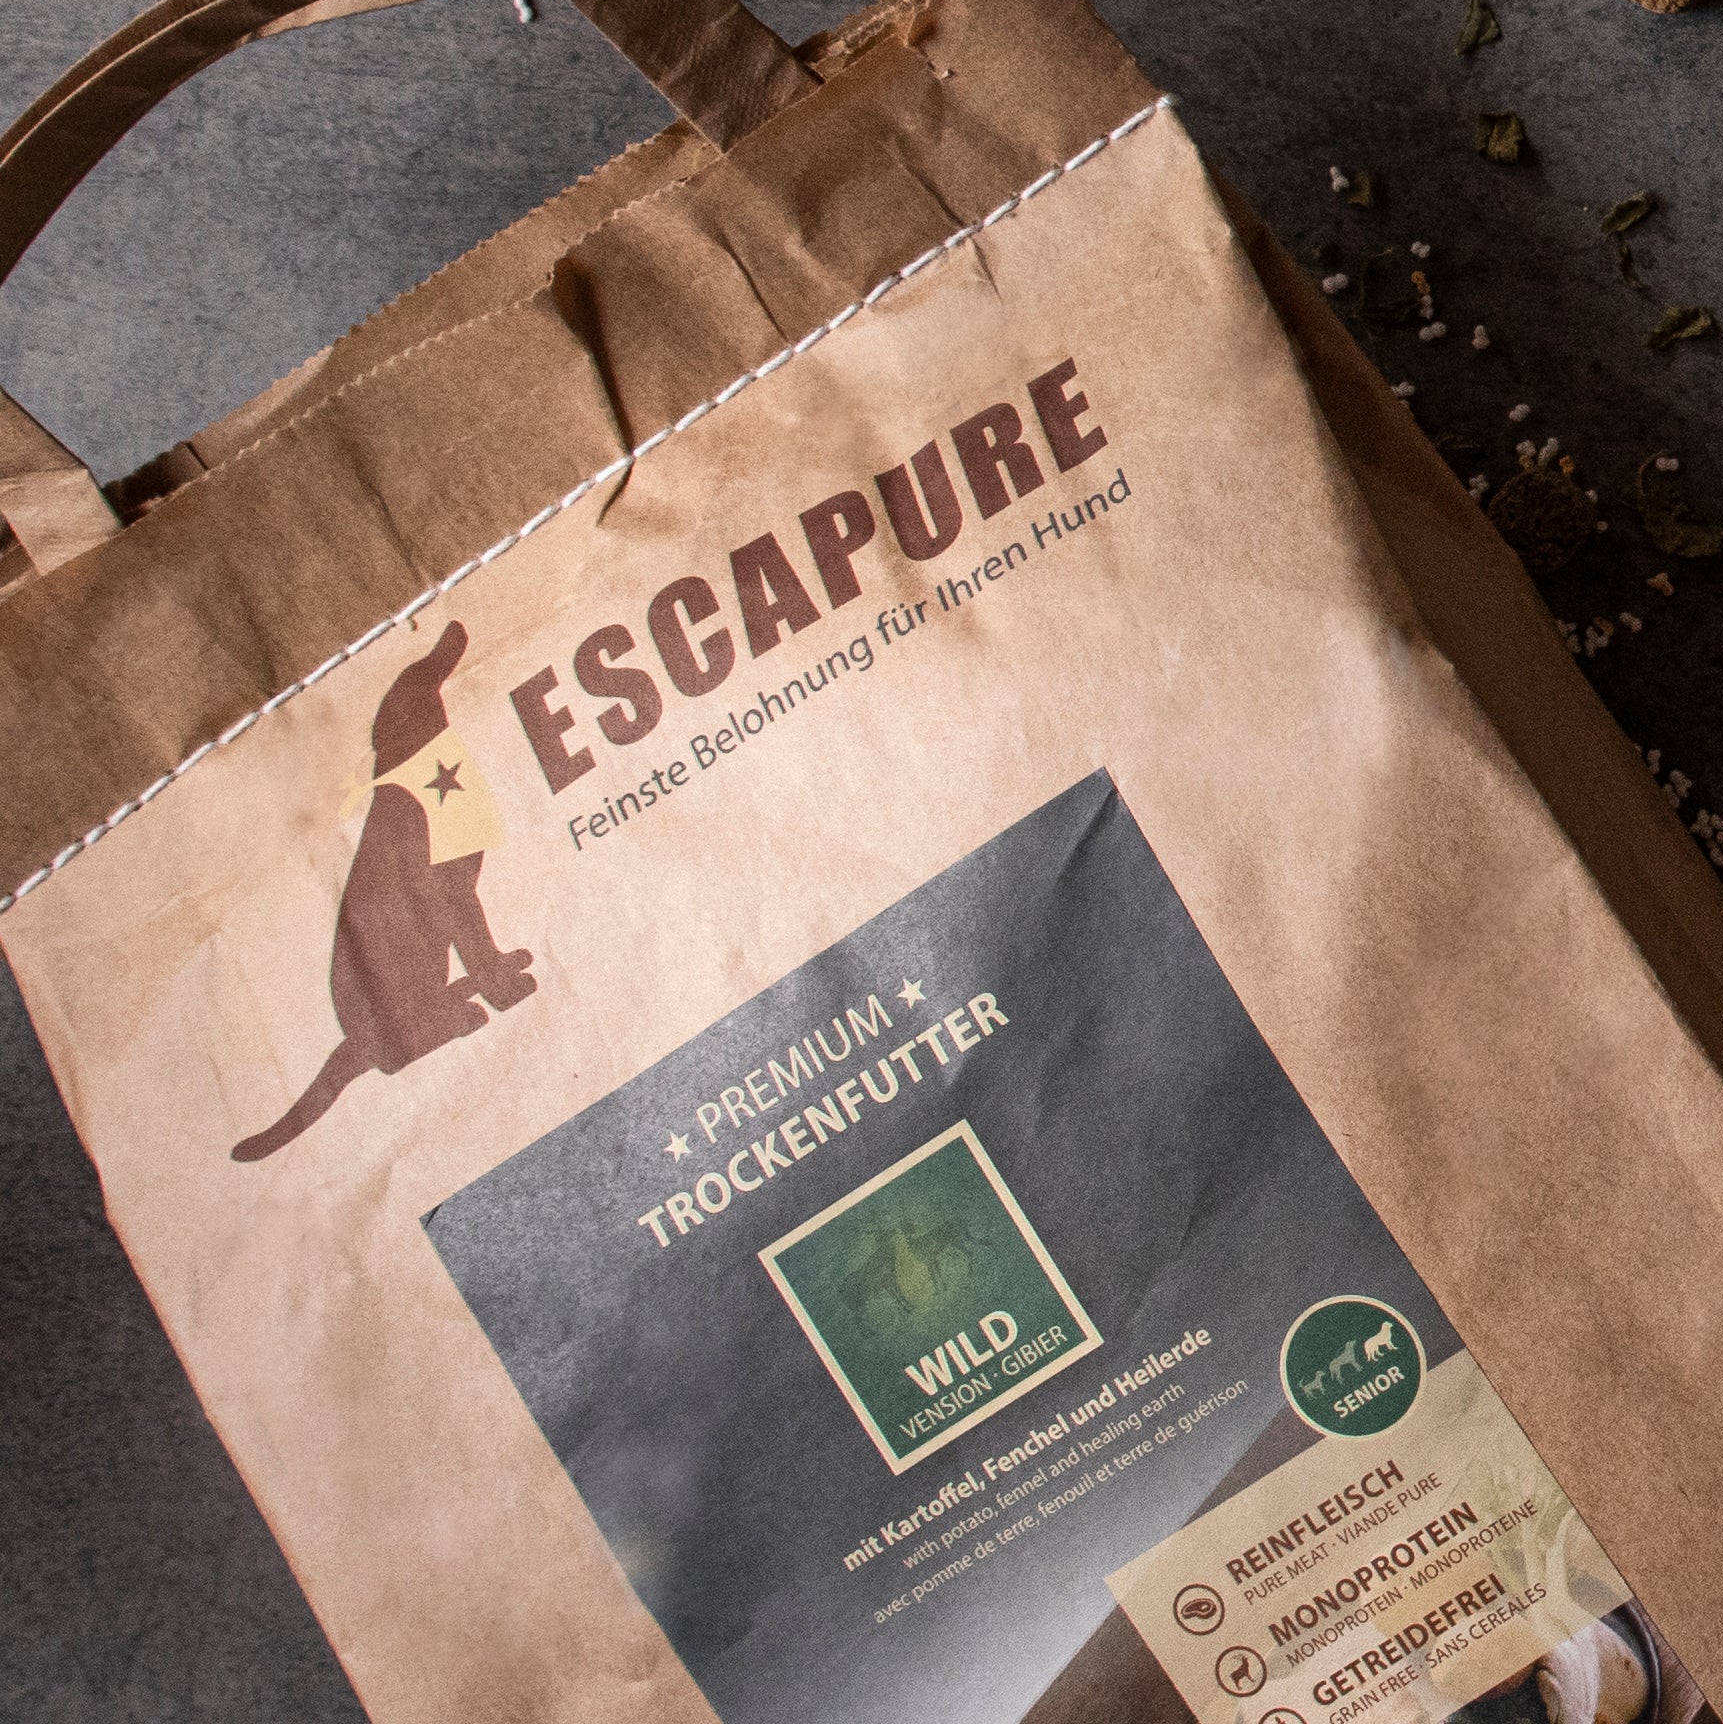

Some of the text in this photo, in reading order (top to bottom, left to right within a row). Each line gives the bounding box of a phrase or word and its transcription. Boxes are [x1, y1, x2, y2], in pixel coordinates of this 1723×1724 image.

[509, 357, 1108, 795] ESCAPURE
[567, 469, 1133, 852] Feinste Belohnung für Ihren Hund
[637, 991, 1010, 1248] TROCKENFUTTER
[694, 994, 895, 1145] PREMIUM
[898, 1324, 1068, 1440] VENSION GIBIER
[904, 1310, 1019, 1397] WILD
[1333, 1365, 1405, 1420] SENIOR
[842, 1326, 1212, 1572] mit Kartoffel, Fenchel und Heilerde
[873, 1379, 1249, 1624] avec pomme de terre, fenouil et terre de guérison
[902, 1382, 1187, 1570] with potato, fennel and healing earth
[1225, 1459, 1405, 1585] REINFLEISCH
[1243, 1472, 1442, 1606] PURE MEAT VIANDE PURE
[1268, 1502, 1479, 1647] MONOPROTEIN
[1286, 1498, 1538, 1668] MONOPROTEIN MONOPROTEINE
[1312, 1573, 1508, 1706] GETREIDEFREI
[1328, 1583, 1547, 1724] GRAIN FREE SANS CEREALES
